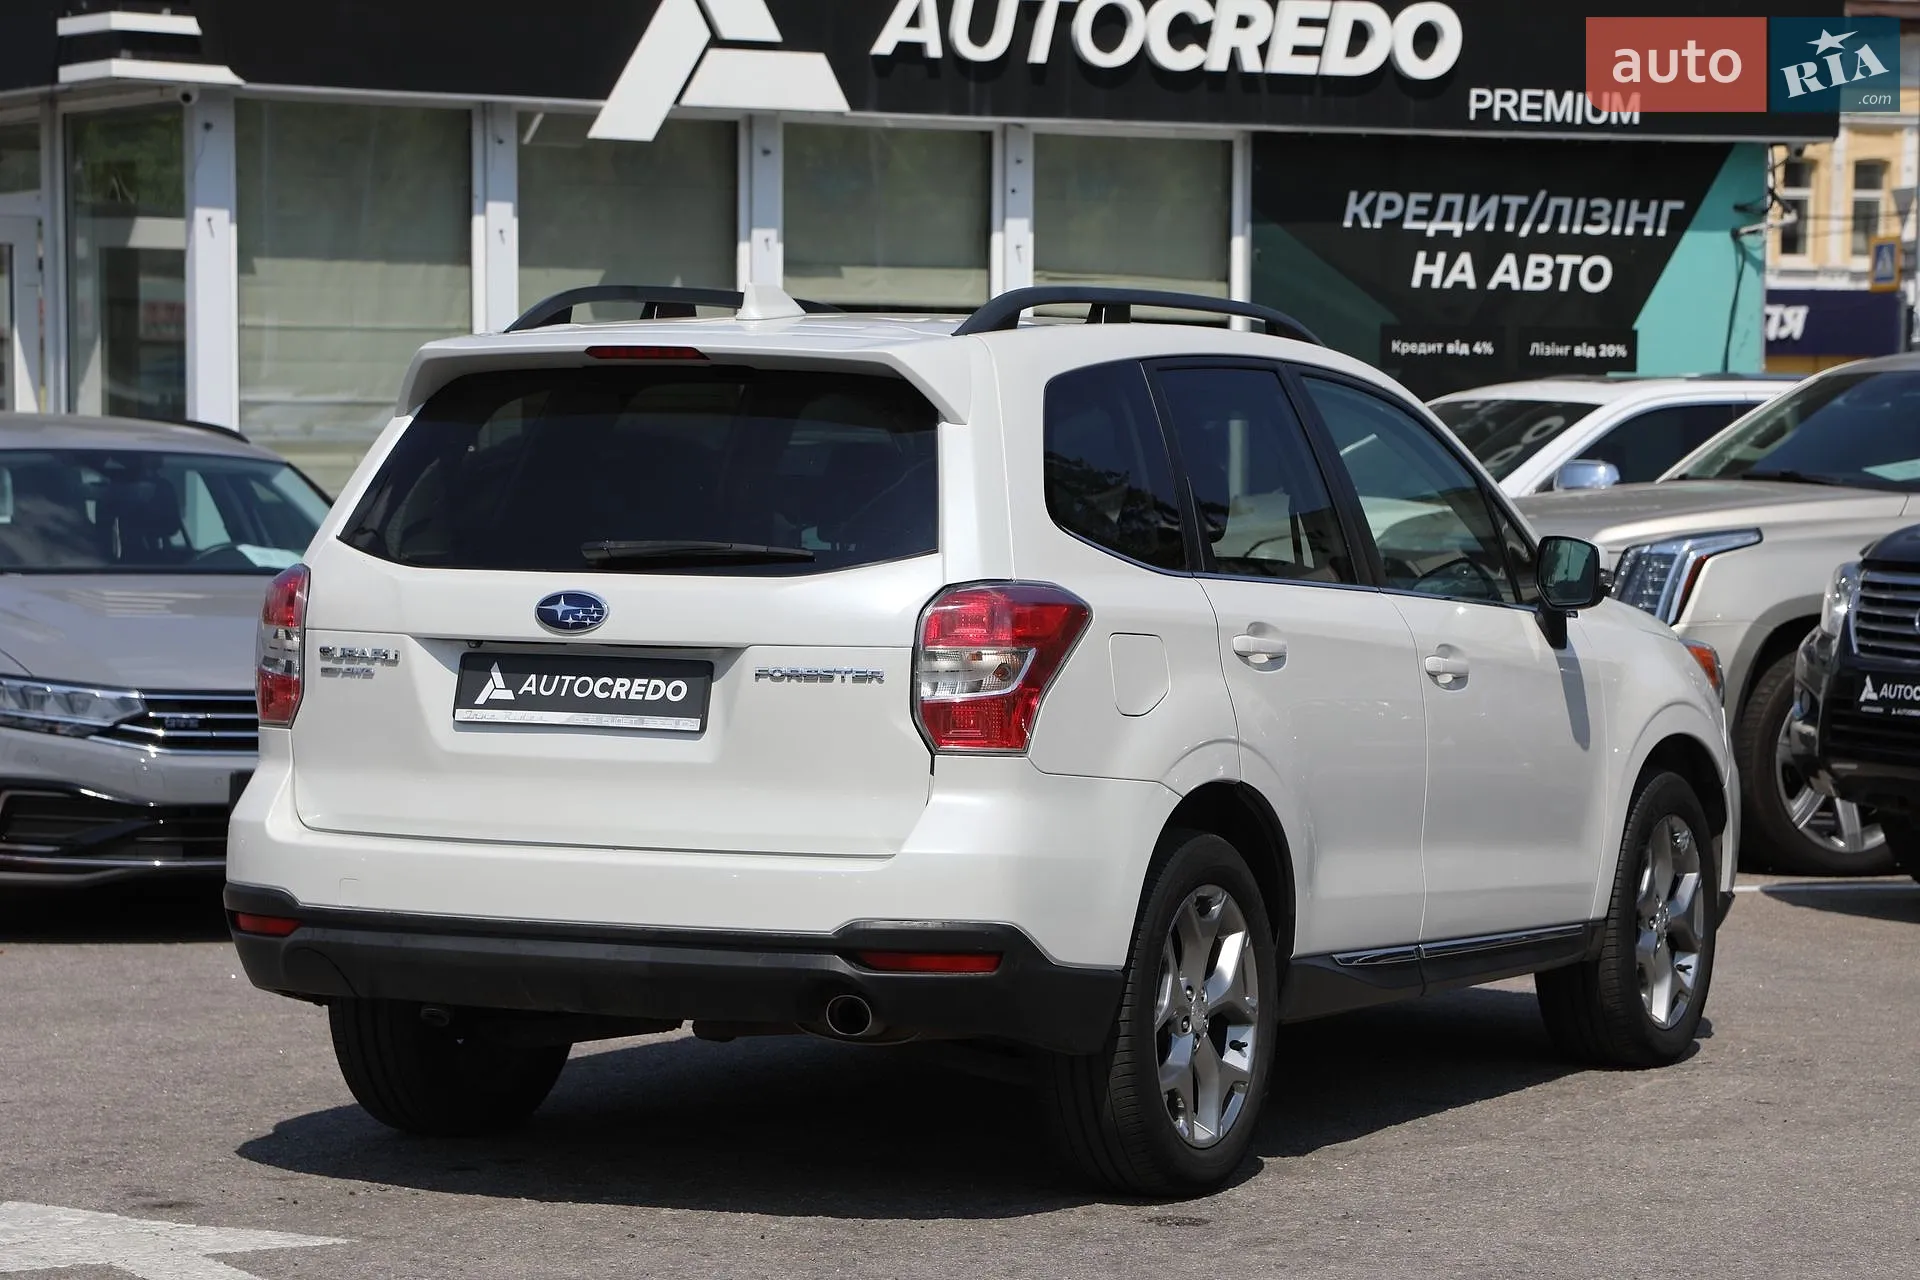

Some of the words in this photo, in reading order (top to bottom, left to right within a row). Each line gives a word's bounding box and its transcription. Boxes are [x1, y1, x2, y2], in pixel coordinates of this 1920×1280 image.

[869, 0, 1464, 80] AUTOCREDO
[1469, 88, 1641, 125] PREMIUM
[1343, 189, 1685, 238] КРЕДИТ/ЛІЗІНГ
[1411, 251, 1477, 290] НА
[1487, 253, 1614, 293] АВТО
[1391, 340, 1444, 355] Кредит
[1446, 340, 1470, 356] від
[1472, 341, 1495, 356] 4%
[1529, 342, 1571, 357] Лізінг
[1573, 342, 1597, 358] від
[1599, 344, 1628, 358] 20%
[319, 646, 400, 666] SUBARU
[518, 673, 688, 702] AUTOCREDO
[754, 667, 885, 683] FORESTER
